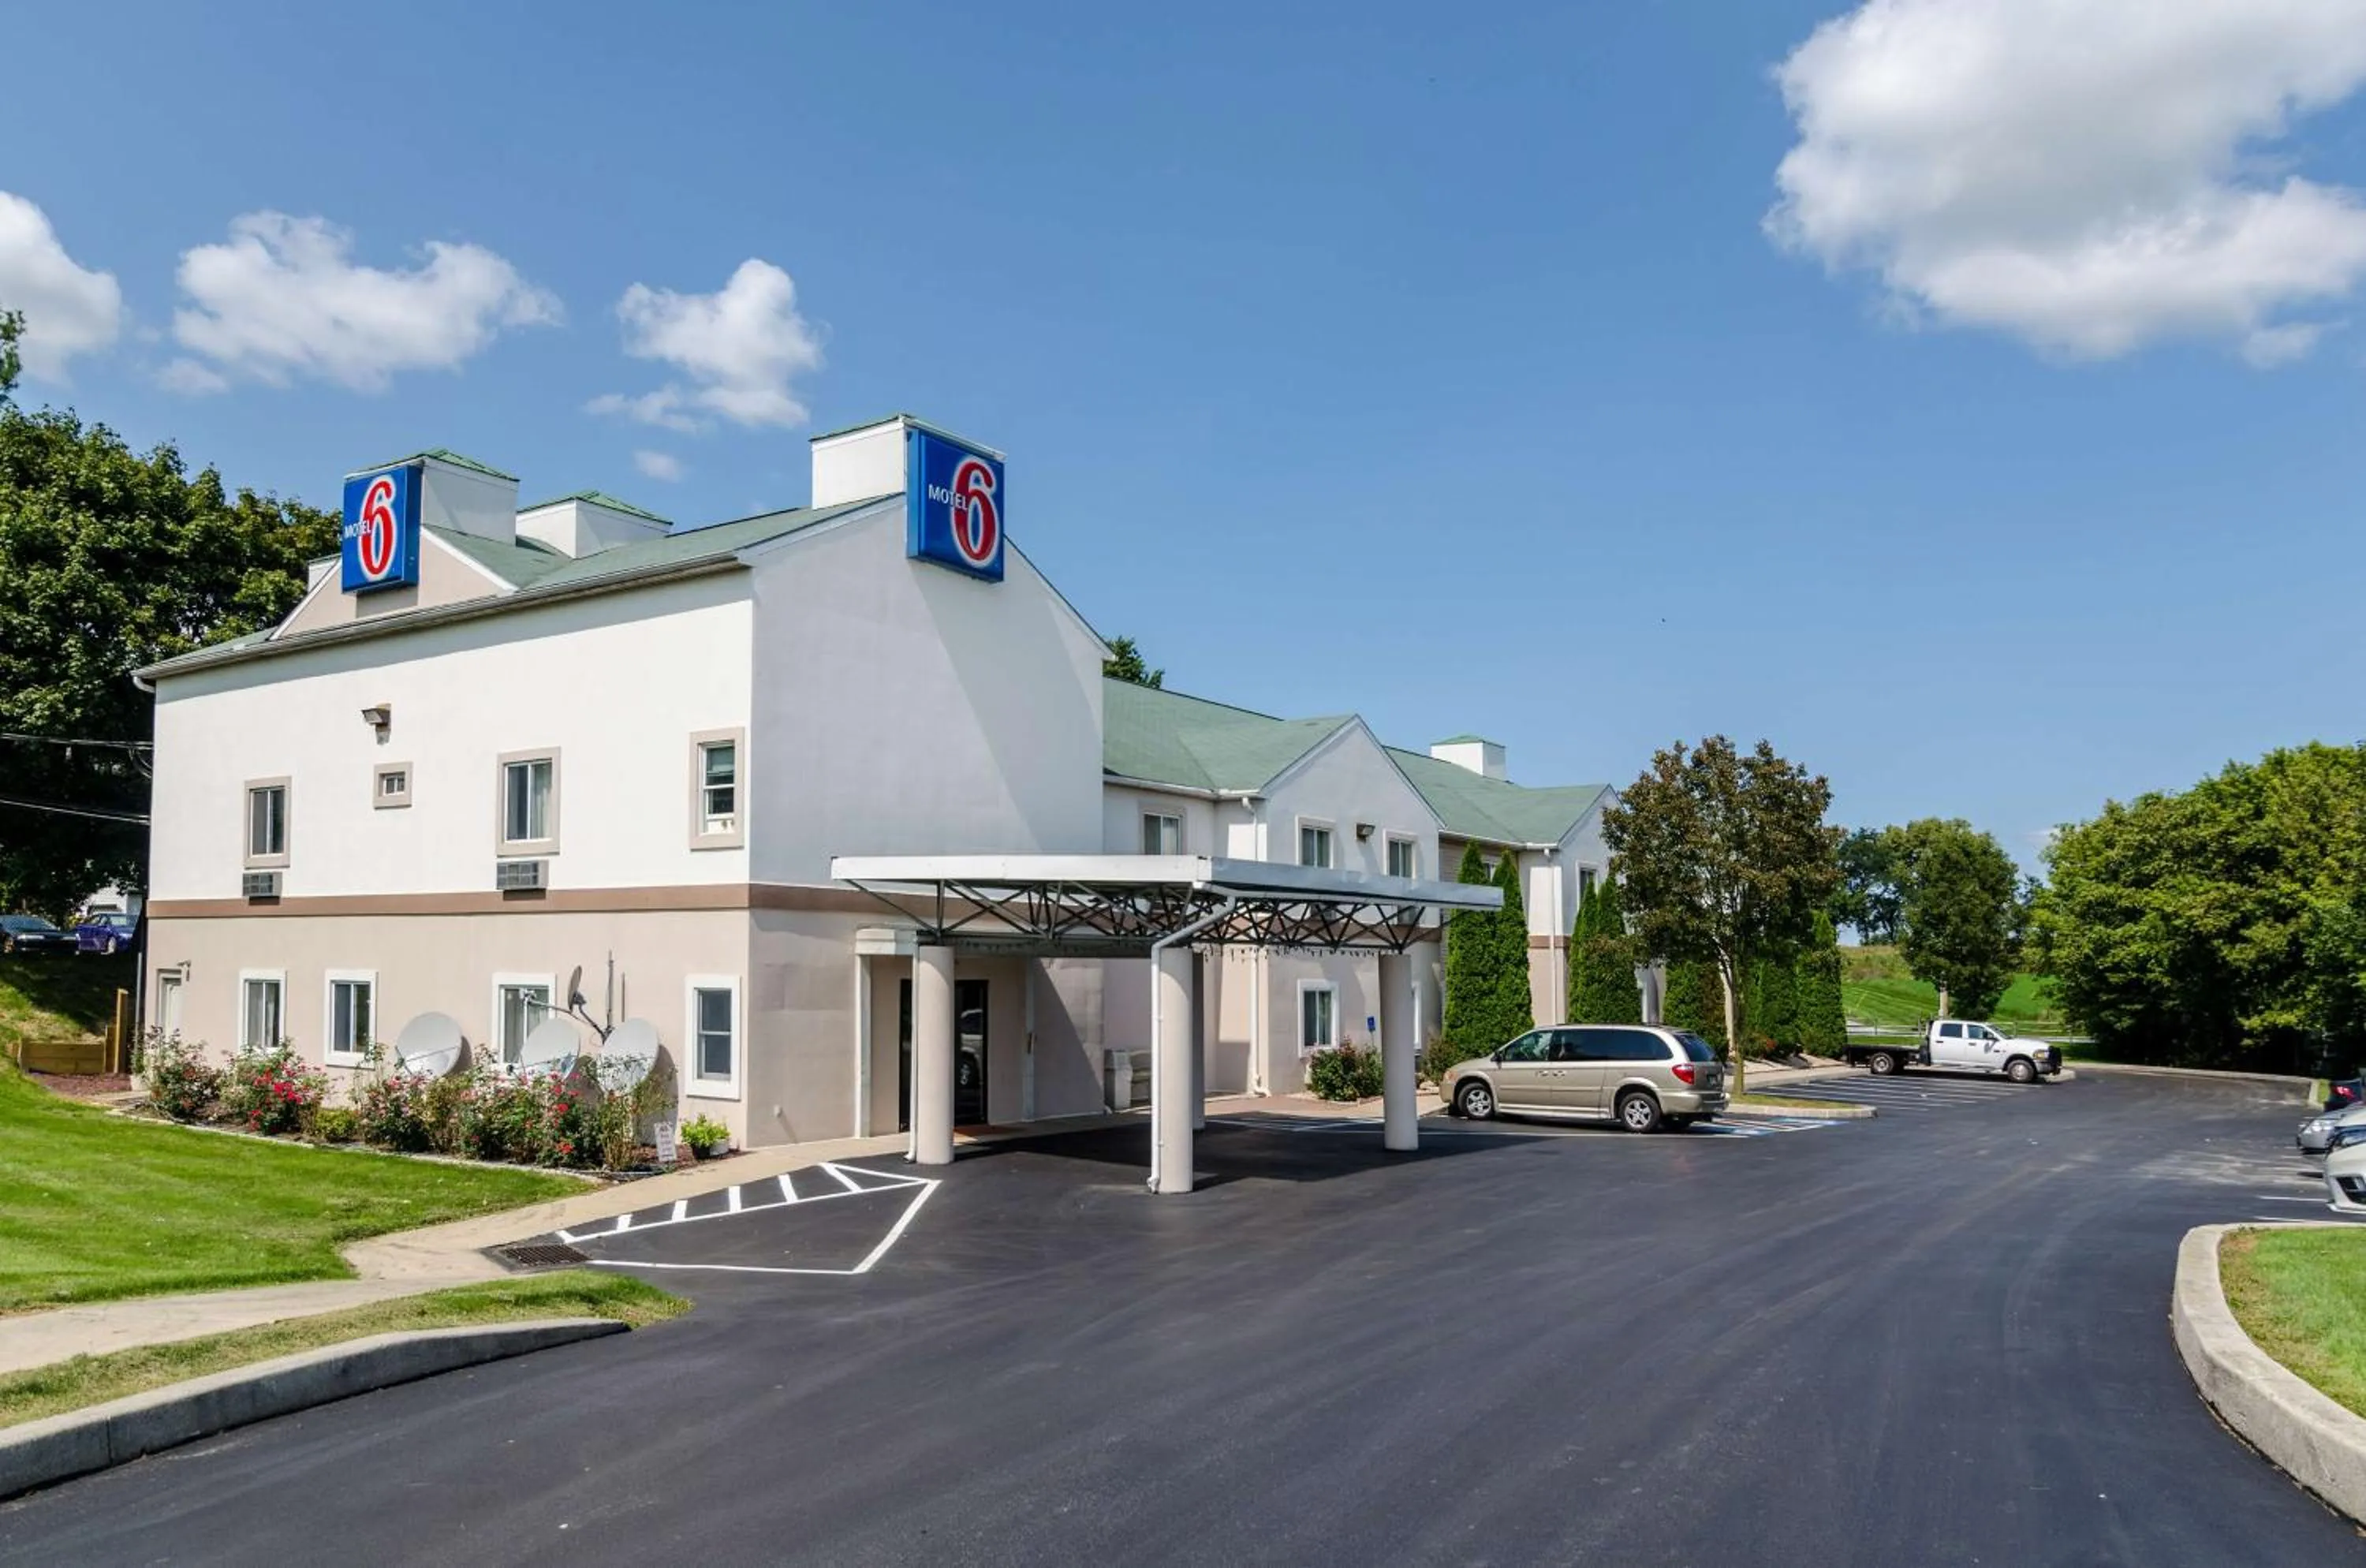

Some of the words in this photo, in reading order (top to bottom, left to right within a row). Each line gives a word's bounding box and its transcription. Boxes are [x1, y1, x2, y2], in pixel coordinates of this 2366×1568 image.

[344, 520, 371, 539] MOTEL
[359, 475, 396, 580] 6
[928, 483, 968, 511] MOTEL
[951, 457, 998, 566] 6
